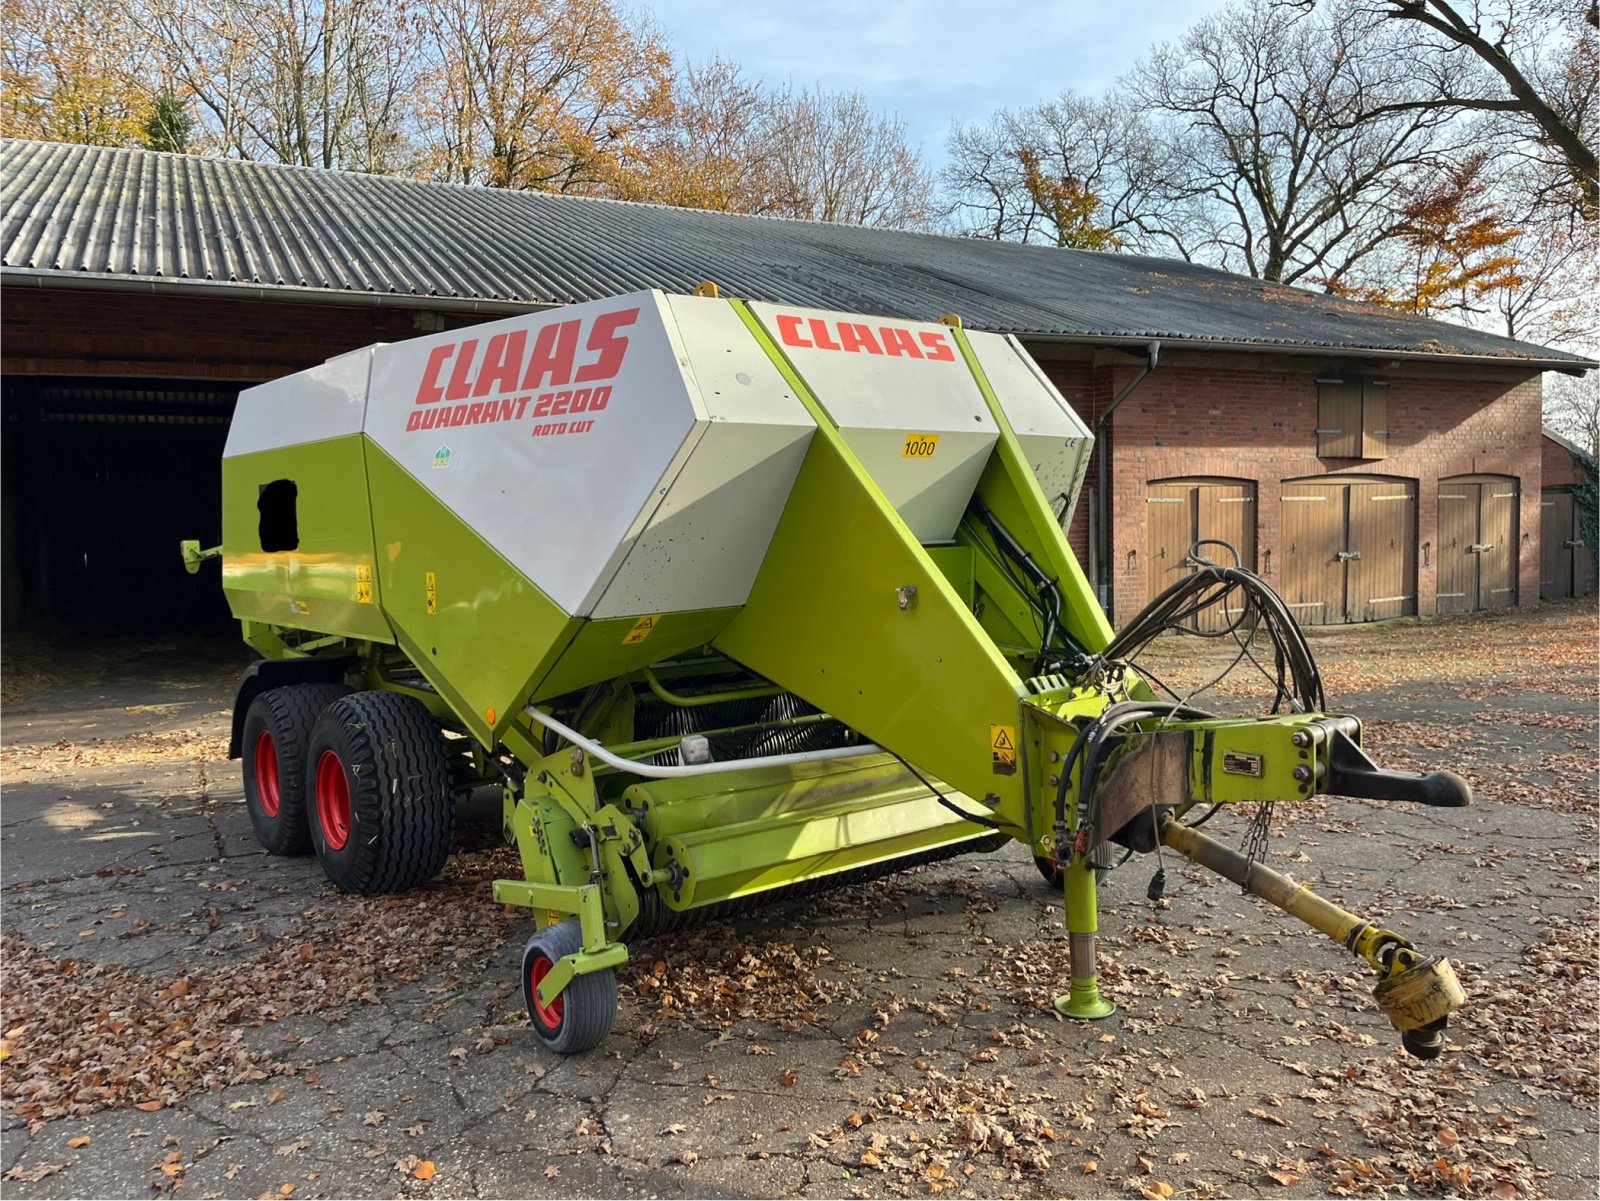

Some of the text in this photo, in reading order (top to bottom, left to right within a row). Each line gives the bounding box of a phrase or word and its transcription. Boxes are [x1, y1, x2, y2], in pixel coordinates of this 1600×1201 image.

[415, 308, 640, 405] CLAAS
[775, 314, 956, 363] CLAAS
[405, 385, 613, 432] QUADRANT 2200
[532, 420, 595, 437] ROTO CUT
[905, 441, 936, 456] 1000
